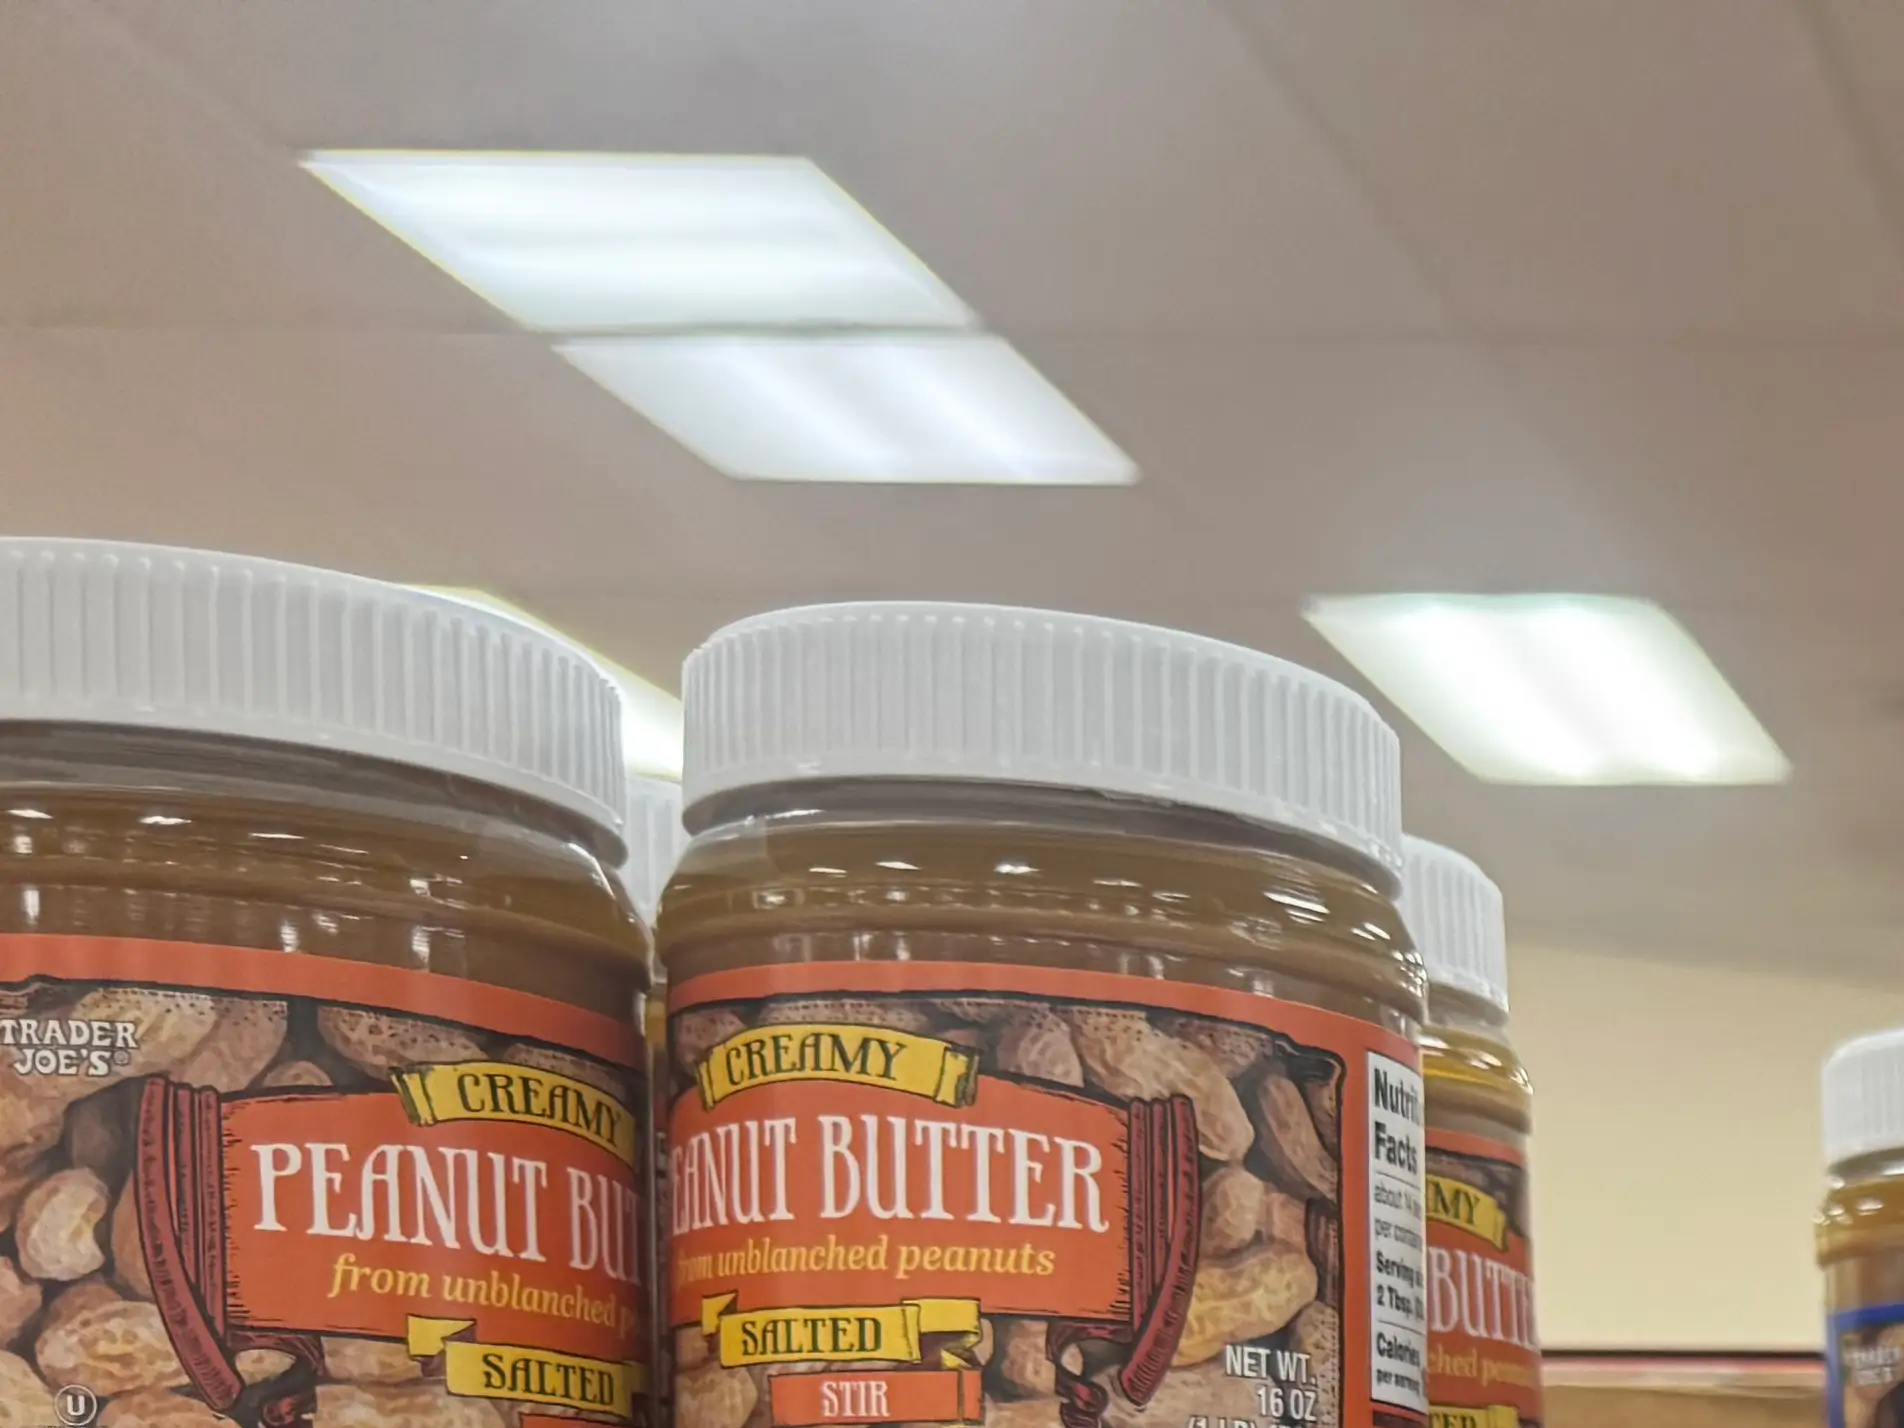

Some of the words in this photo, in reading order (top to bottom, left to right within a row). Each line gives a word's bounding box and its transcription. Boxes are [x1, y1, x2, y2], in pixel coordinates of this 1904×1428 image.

[1, 1020, 138, 1049] TRADER
[724, 1032, 905, 1085] CREAMY
[455, 1070, 625, 1150] CREAMY
[1374, 1121, 1418, 1175] Facts
[250, 1141, 547, 1262] PEANUT
[671, 1116, 797, 1236] EANUT
[819, 1115, 1110, 1233] BUTTER
[717, 1236, 888, 1275] unblanched
[897, 1241, 1056, 1277] peanuts
[327, 1253, 432, 1299] from
[442, 1268, 617, 1328] unblanched
[741, 1315, 883, 1355] SALTED
[481, 1353, 617, 1406] SALTED
[1224, 1348, 1270, 1377] NET
[1272, 1351, 1318, 1383] WT.
[820, 1378, 891, 1418] STIR
[1257, 1387, 1277, 1417] 16
[1281, 1390, 1318, 1422] OZ
